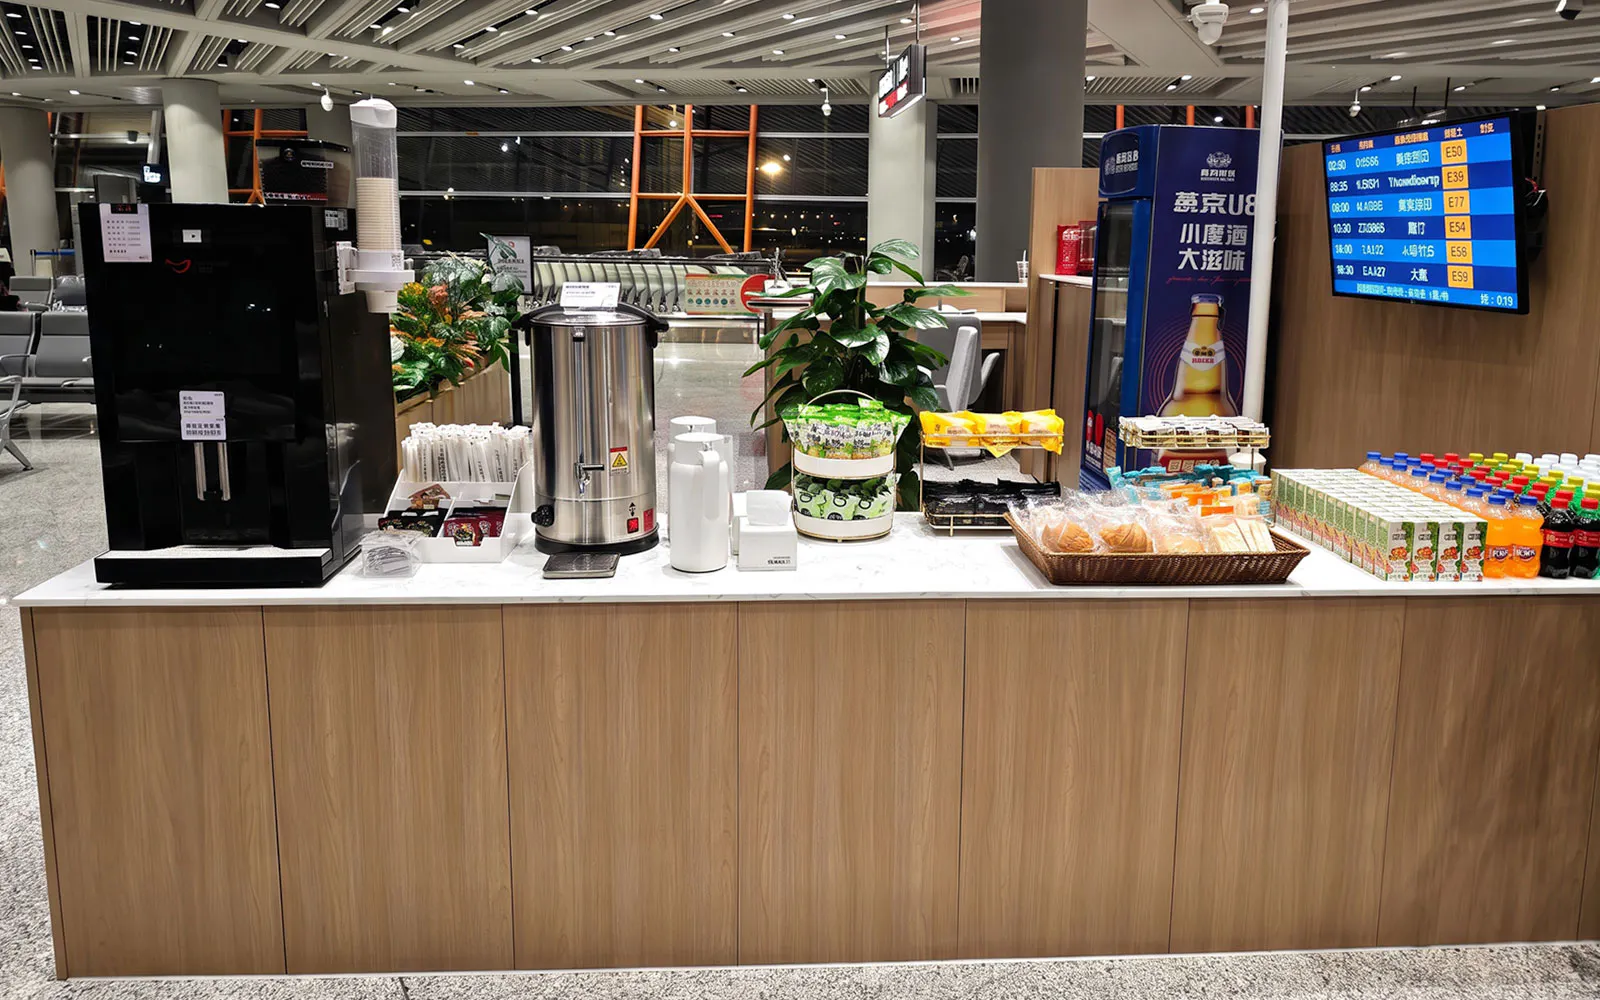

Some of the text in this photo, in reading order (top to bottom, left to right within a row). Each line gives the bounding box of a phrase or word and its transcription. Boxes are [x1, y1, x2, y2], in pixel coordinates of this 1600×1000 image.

[1447, 171, 1465, 183] E39
[1449, 221, 1466, 233] E54
[1450, 246, 1467, 258] E58
[1177, 248, 1246, 271] 大滋味
[1451, 270, 1469, 283] E59
